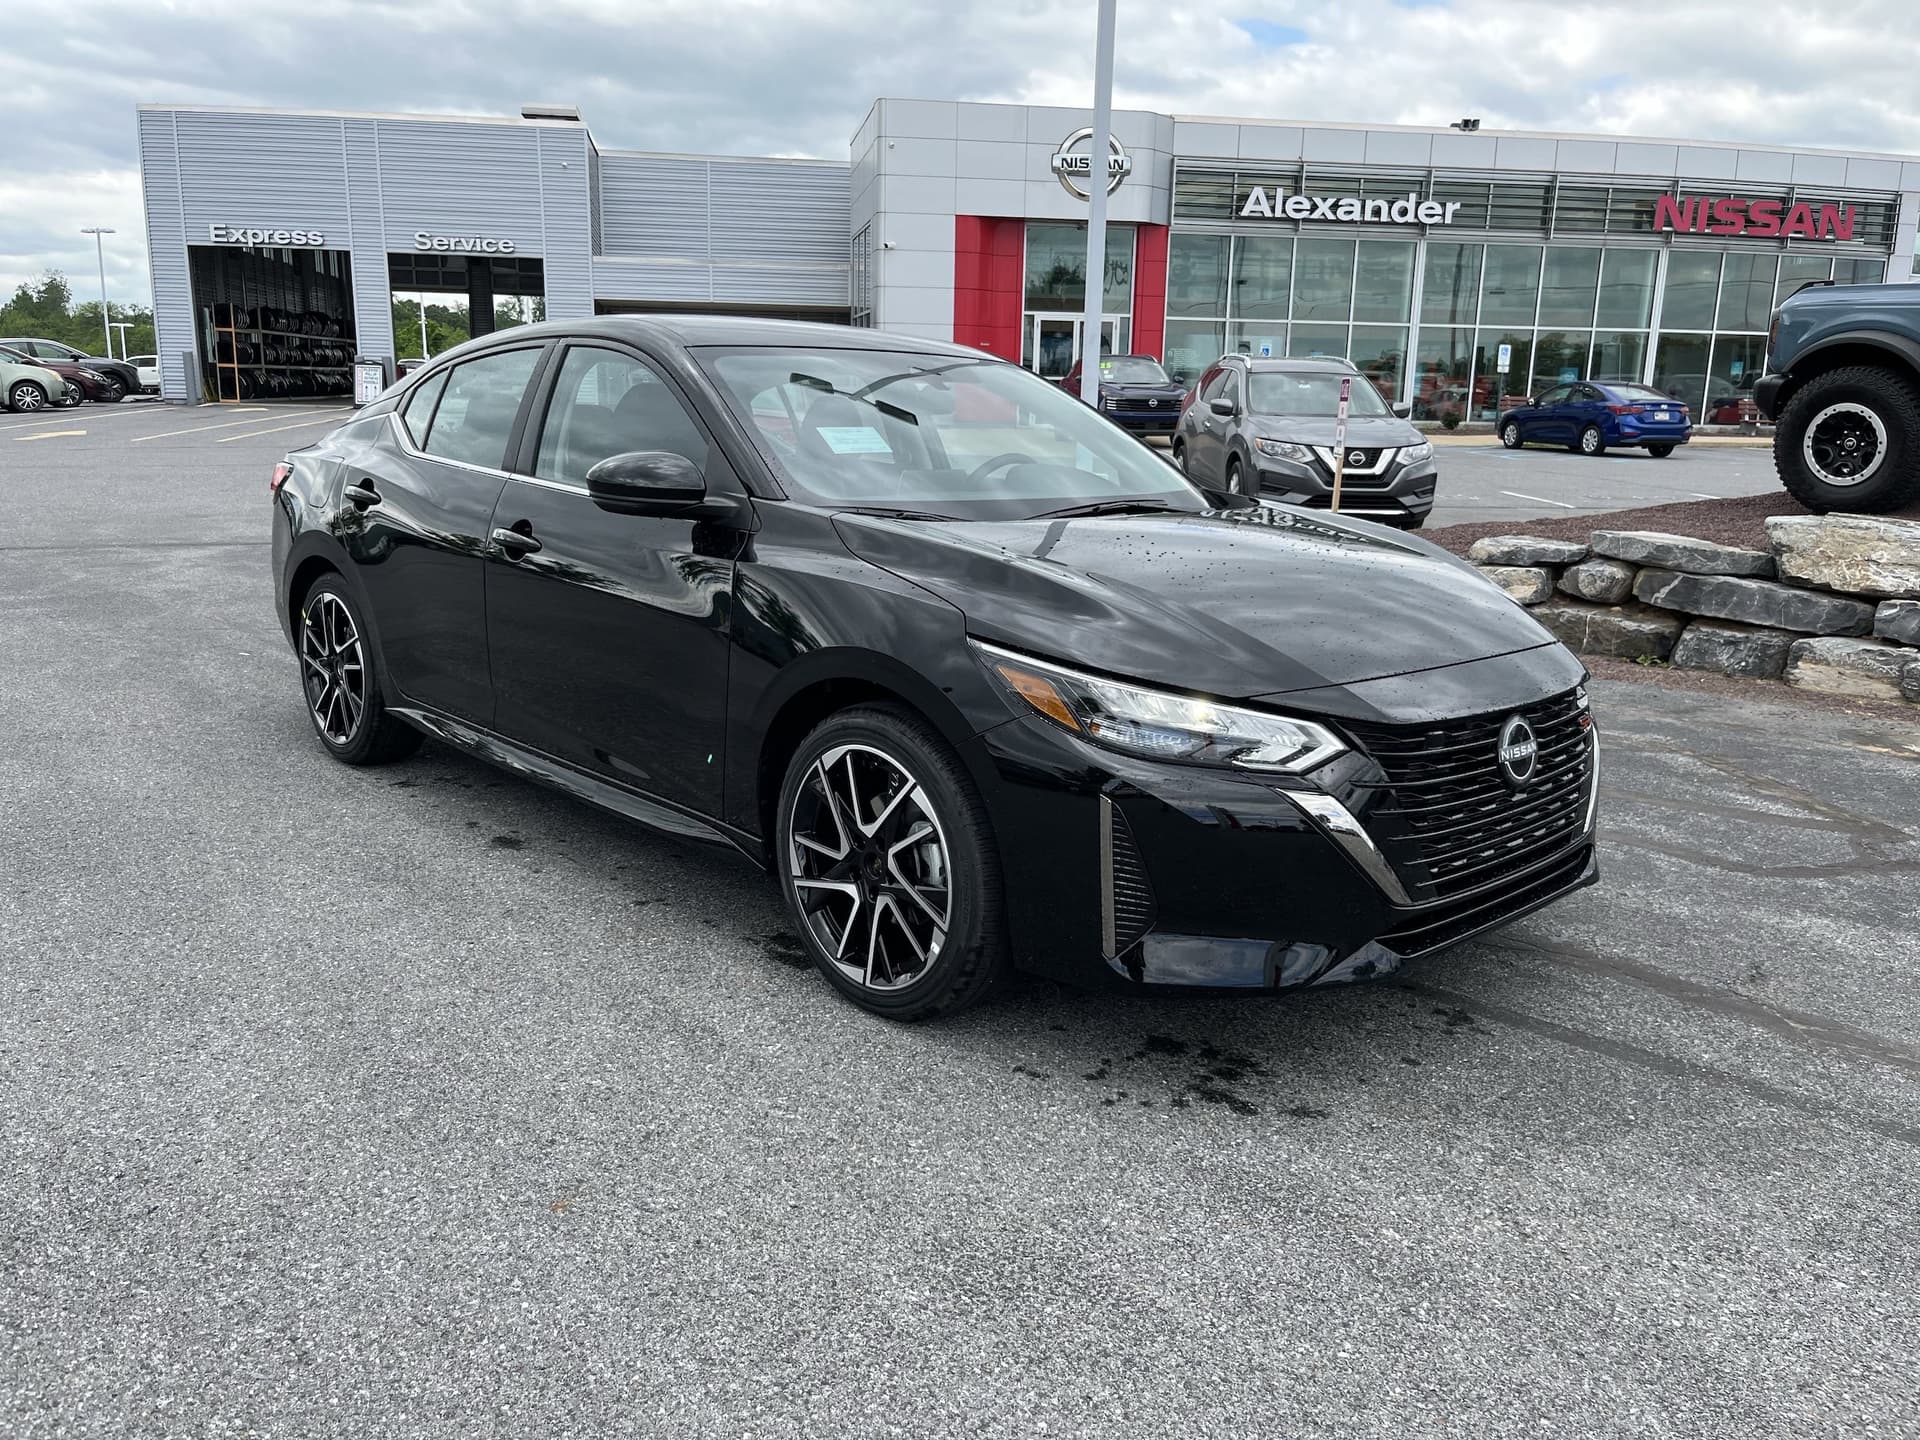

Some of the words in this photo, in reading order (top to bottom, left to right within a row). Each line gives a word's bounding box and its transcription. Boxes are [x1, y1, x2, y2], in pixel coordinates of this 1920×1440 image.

[1061, 157, 1124, 171] NISN
[1239, 186, 1461, 225] Alexander
[1653, 194, 1856, 241] NISSAN
[208, 223, 325, 247] Express
[414, 231, 515, 253] Service
[1501, 742, 1537, 761] NISSAN
